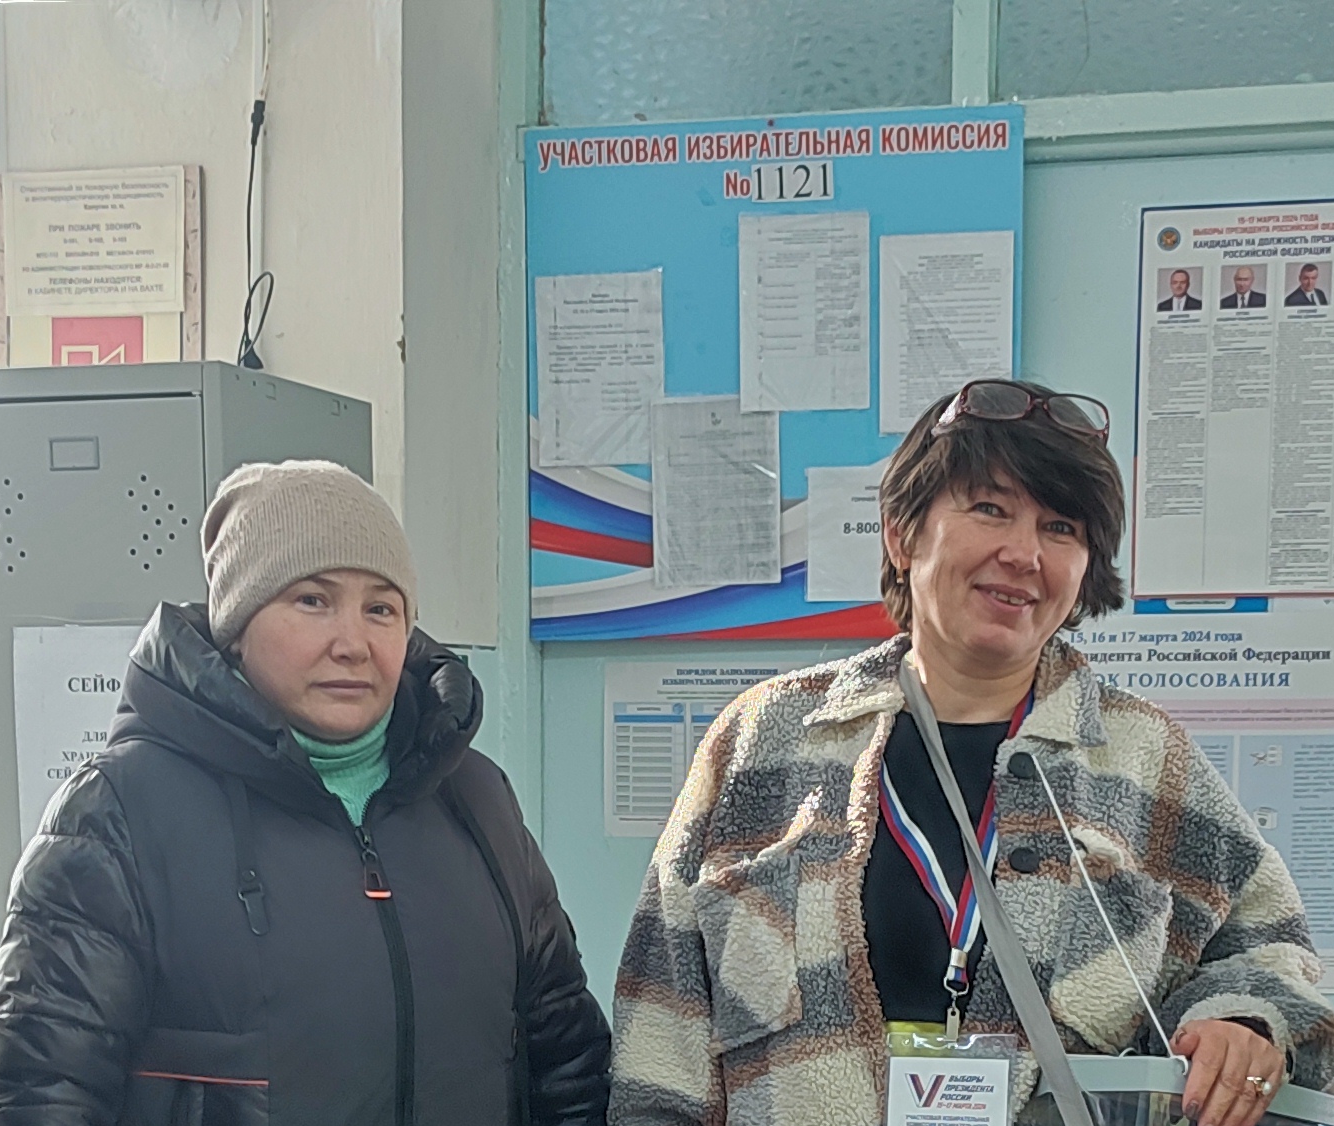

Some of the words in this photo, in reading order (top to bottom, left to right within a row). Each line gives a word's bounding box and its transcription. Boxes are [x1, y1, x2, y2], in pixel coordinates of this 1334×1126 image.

[539, 136, 678, 171] УЧАСТКОВАЯ
[687, 127, 871, 162] ИЗБИРАТЕЛЬНАЯ
[881, 122, 1007, 153] КОМИССИЯ
[1193, 238, 1243, 249] КАНДИДАТЫ
[1245, 238, 1256, 246] НА
[1257, 235, 1309, 247] ДОЛЖНОСТЬ
[1222, 247, 1278, 259] РОССИЙСКОЙ
[1279, 246, 1331, 257] ФЕДЕРАЦИИ
[1091, 632, 1106, 643] 16
[1108, 634, 1118, 643] и
[1121, 631, 1136, 643] 17
[1138, 633, 1178, 646] марта
[1181, 630, 1211, 643] 2024
[1214, 632, 1243, 645] года
[1084, 651, 1142, 664] идента
[1146, 648, 1237, 662] Российской
[1242, 647, 1331, 664] Федерации
[1127, 672, 1291, 688] ГОЛОСОВАНИЯ
[82, 731, 107, 743] ДЛЯ
[948, 1075, 985, 1083] ВЫБОРЫ
[944, 1084, 995, 1093] ПРЕЗИДЕНТА
[940, 1093, 972, 1101] РОССИИ
